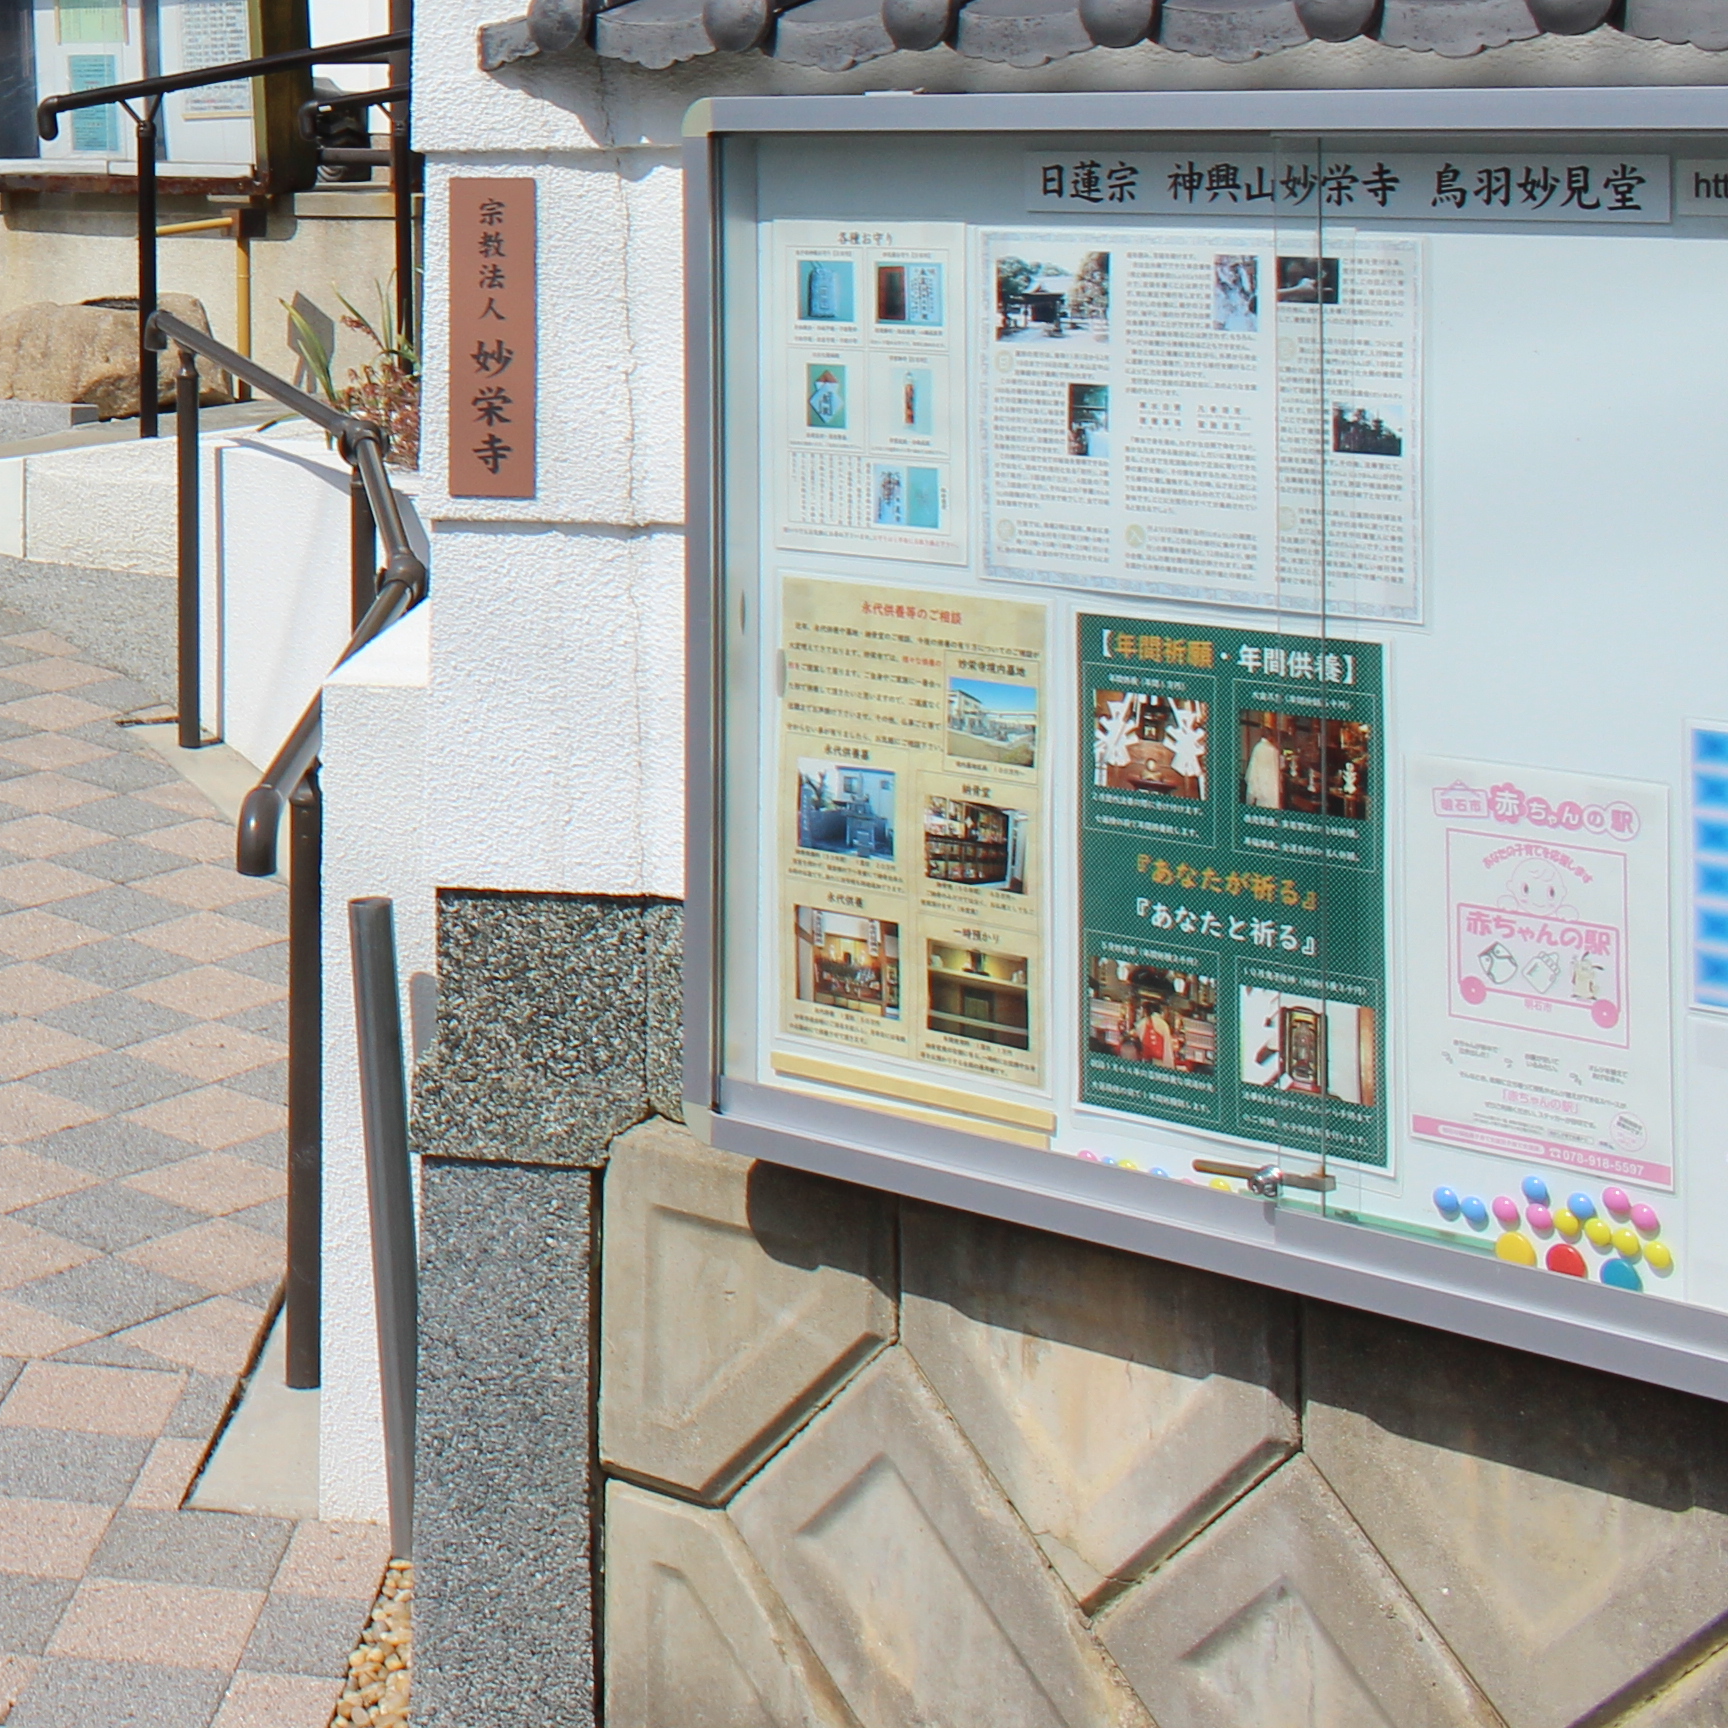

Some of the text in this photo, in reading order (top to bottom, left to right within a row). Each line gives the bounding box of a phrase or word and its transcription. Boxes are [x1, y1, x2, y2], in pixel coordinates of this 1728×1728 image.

[1042, 161, 1647, 211] 日蓮宗 神興山妙栄寺 鳥羽妙見堂
[838, 232, 894, 247] 各種お守り
[471, 198, 514, 475] 宗教法人 妙栄寺
[861, 600, 963, 625] 永代供養等のご相談
[957, 659, 1027, 678] 妙栄寺境内墓地
[824, 744, 870, 761] 永代供養墓
[962, 783, 992, 799] 納骨堂
[1440, 798, 1482, 813] 明石市
[1495, 790, 1635, 834] 赤ちゃんの駅
[1136, 853, 1320, 911] 『あなたが祈る』
[827, 891, 864, 909] 永代供養
[953, 927, 1001, 944] 一時預かり
[1136, 897, 1318, 957] 『あなたと祈る』
[1465, 910, 1612, 956] 赤ちゃんの駅
[1524, 998, 1553, 1013] 明石市
[1563, 1152, 1645, 1176] 078-918-5597
